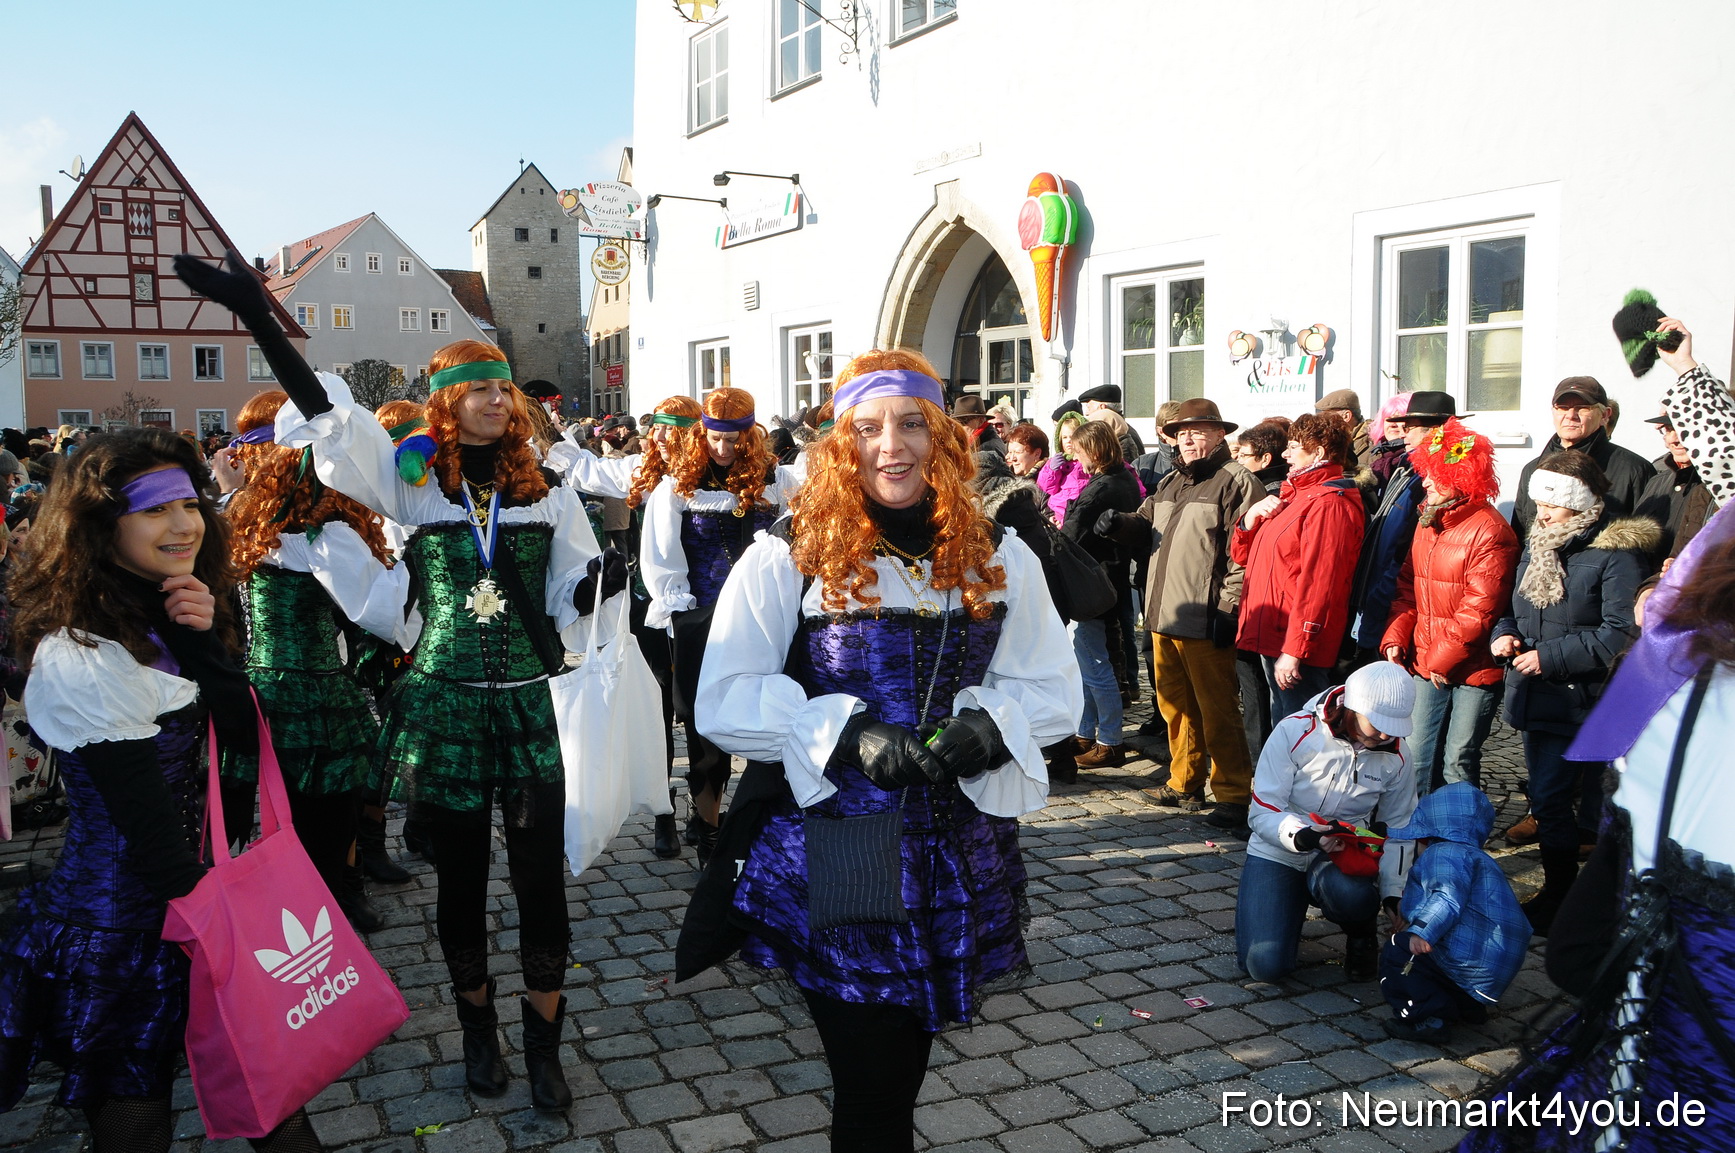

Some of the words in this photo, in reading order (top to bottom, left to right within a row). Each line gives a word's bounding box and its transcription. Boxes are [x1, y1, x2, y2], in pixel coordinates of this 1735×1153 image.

[593, 183, 627, 193] Pizzeria
[601, 194, 619, 203] Café
[593, 204, 627, 215] Eisdiele
[598, 222, 622, 230] Bella
[728, 222, 751, 241] Bella
[754, 217, 782, 233] Roma
[1266, 361, 1291, 376] Eis
[1249, 379, 1307, 394] Kuchen
[286, 965, 360, 1030] adidas
